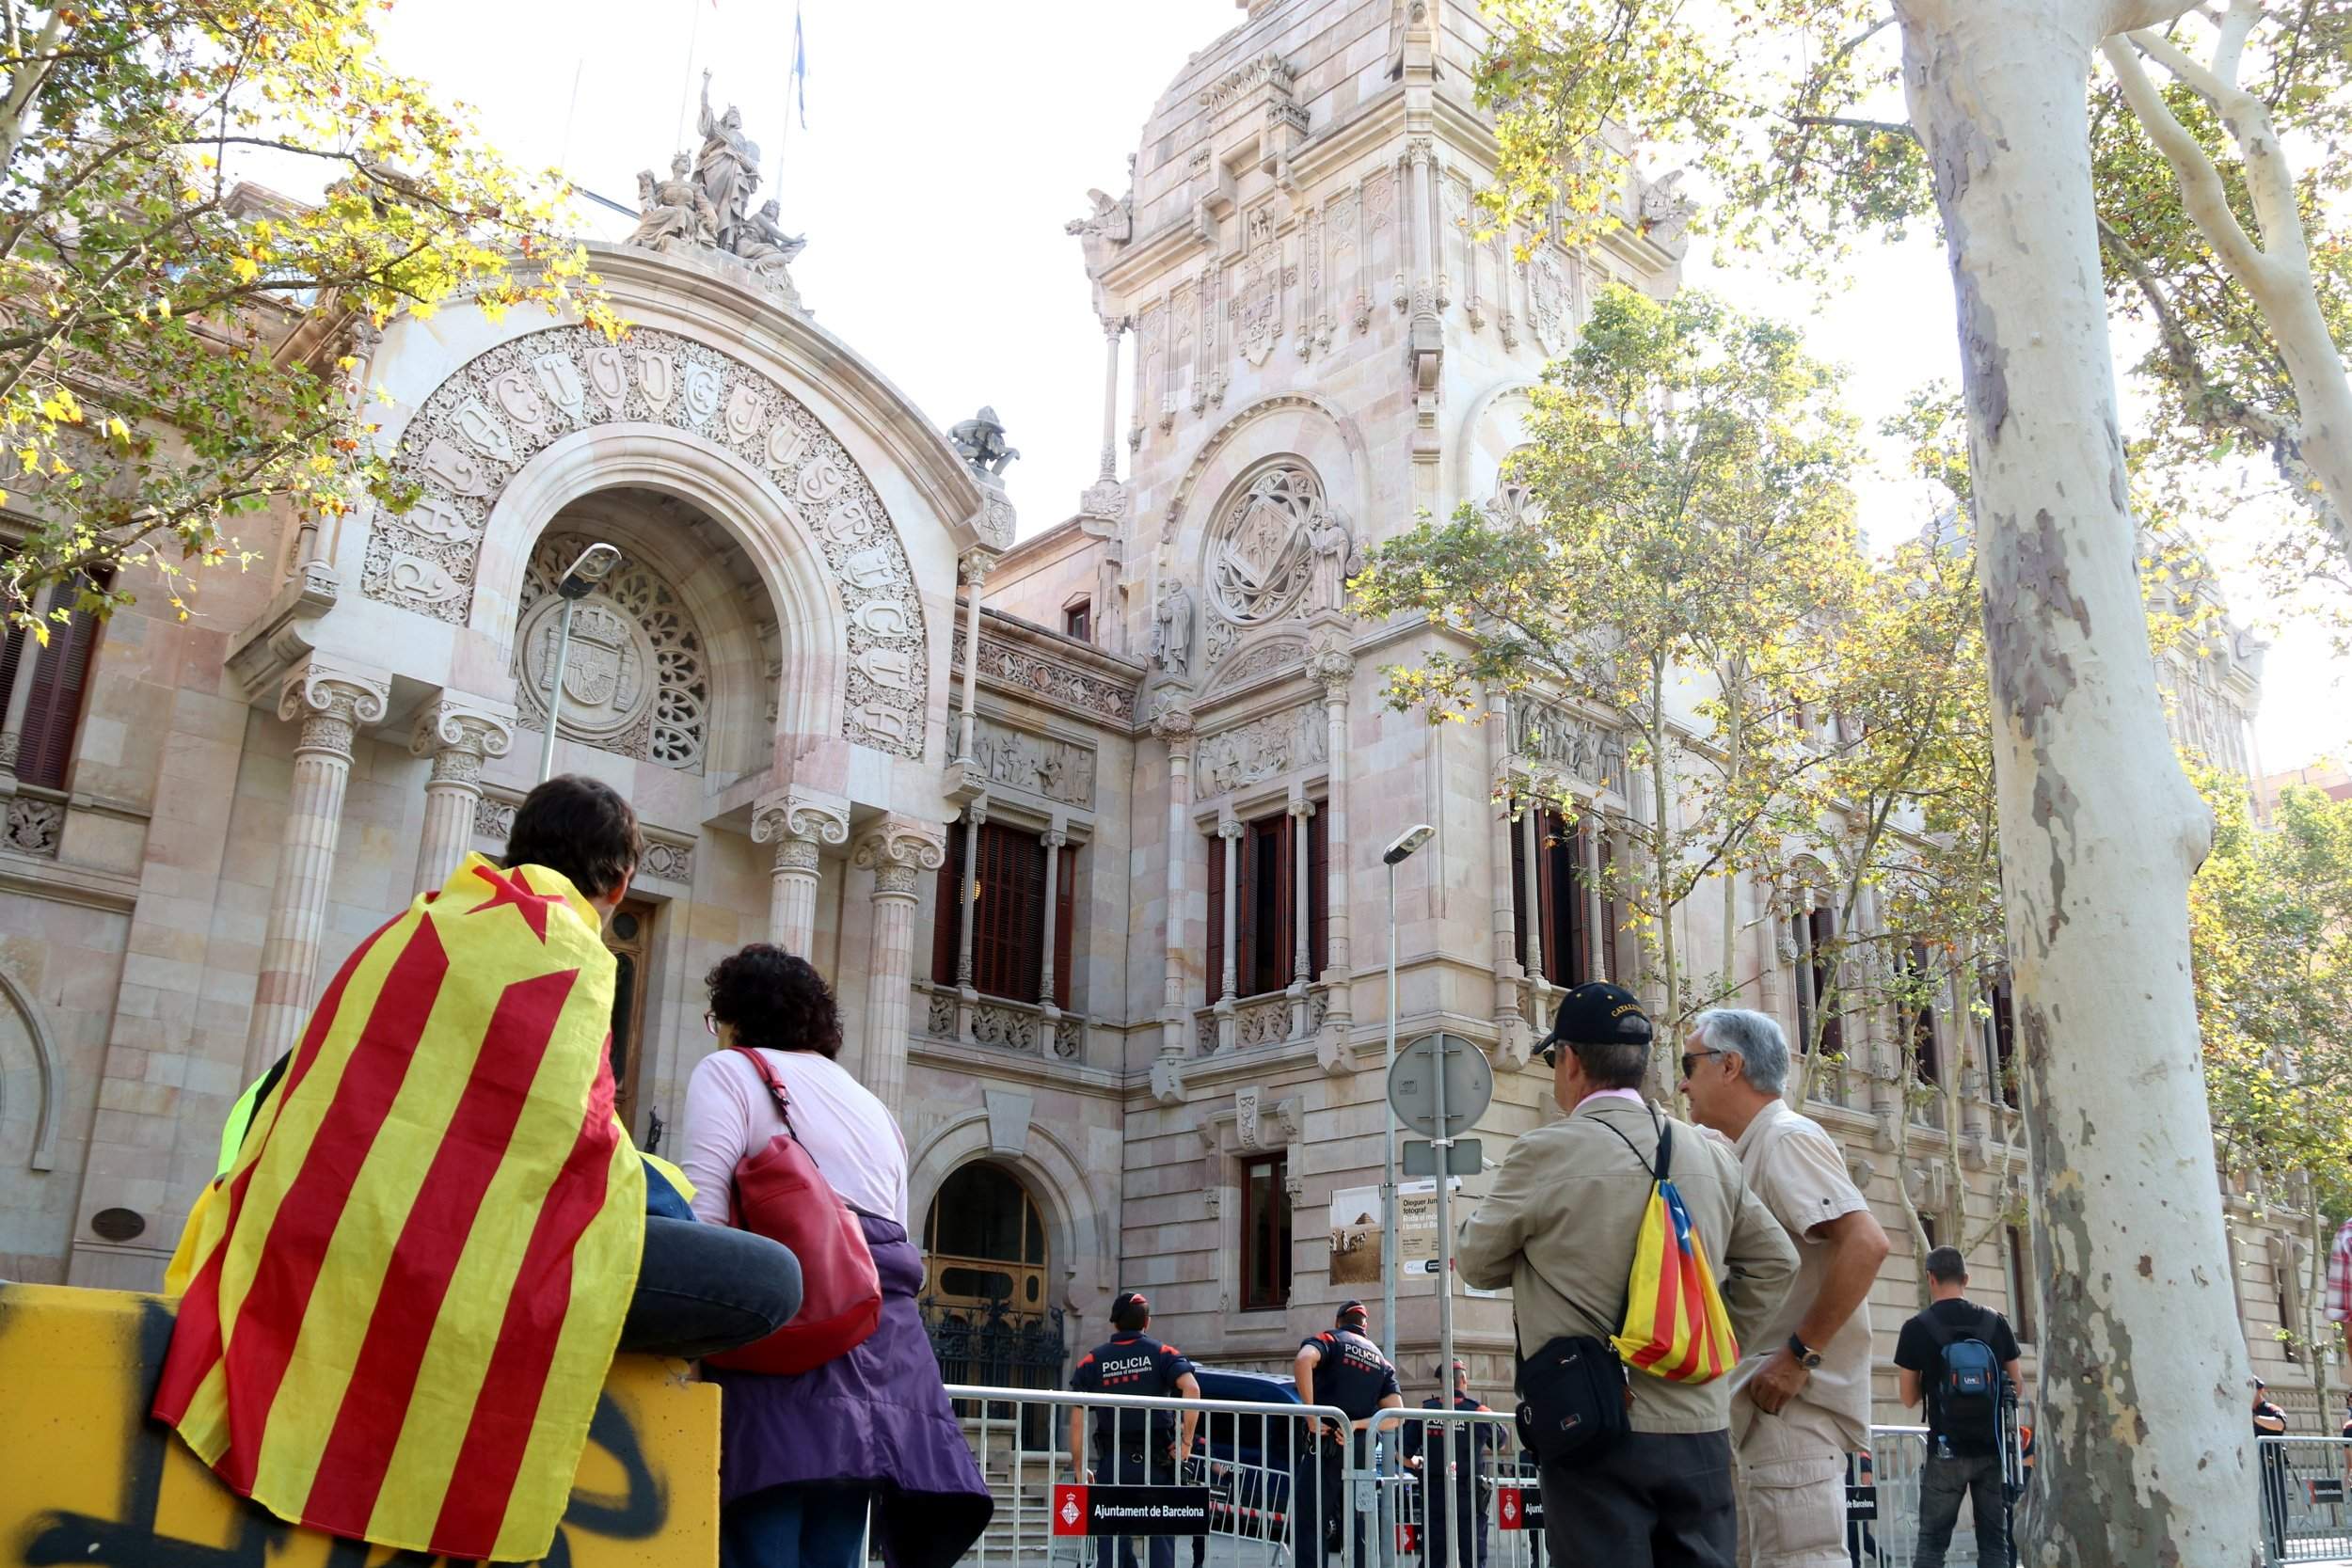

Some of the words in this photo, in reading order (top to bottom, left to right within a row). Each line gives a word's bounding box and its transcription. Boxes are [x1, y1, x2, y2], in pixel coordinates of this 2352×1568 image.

[1344, 1343, 1380, 1365] POLICIA
[1102, 1355, 1152, 1373] POLICIA
[1094, 1504, 1149, 1519] Ajuntament
[1150, 1505, 1161, 1517] de
[1162, 1505, 1204, 1517] Barcelona
[1852, 1498, 1874, 1509] Barcelona
